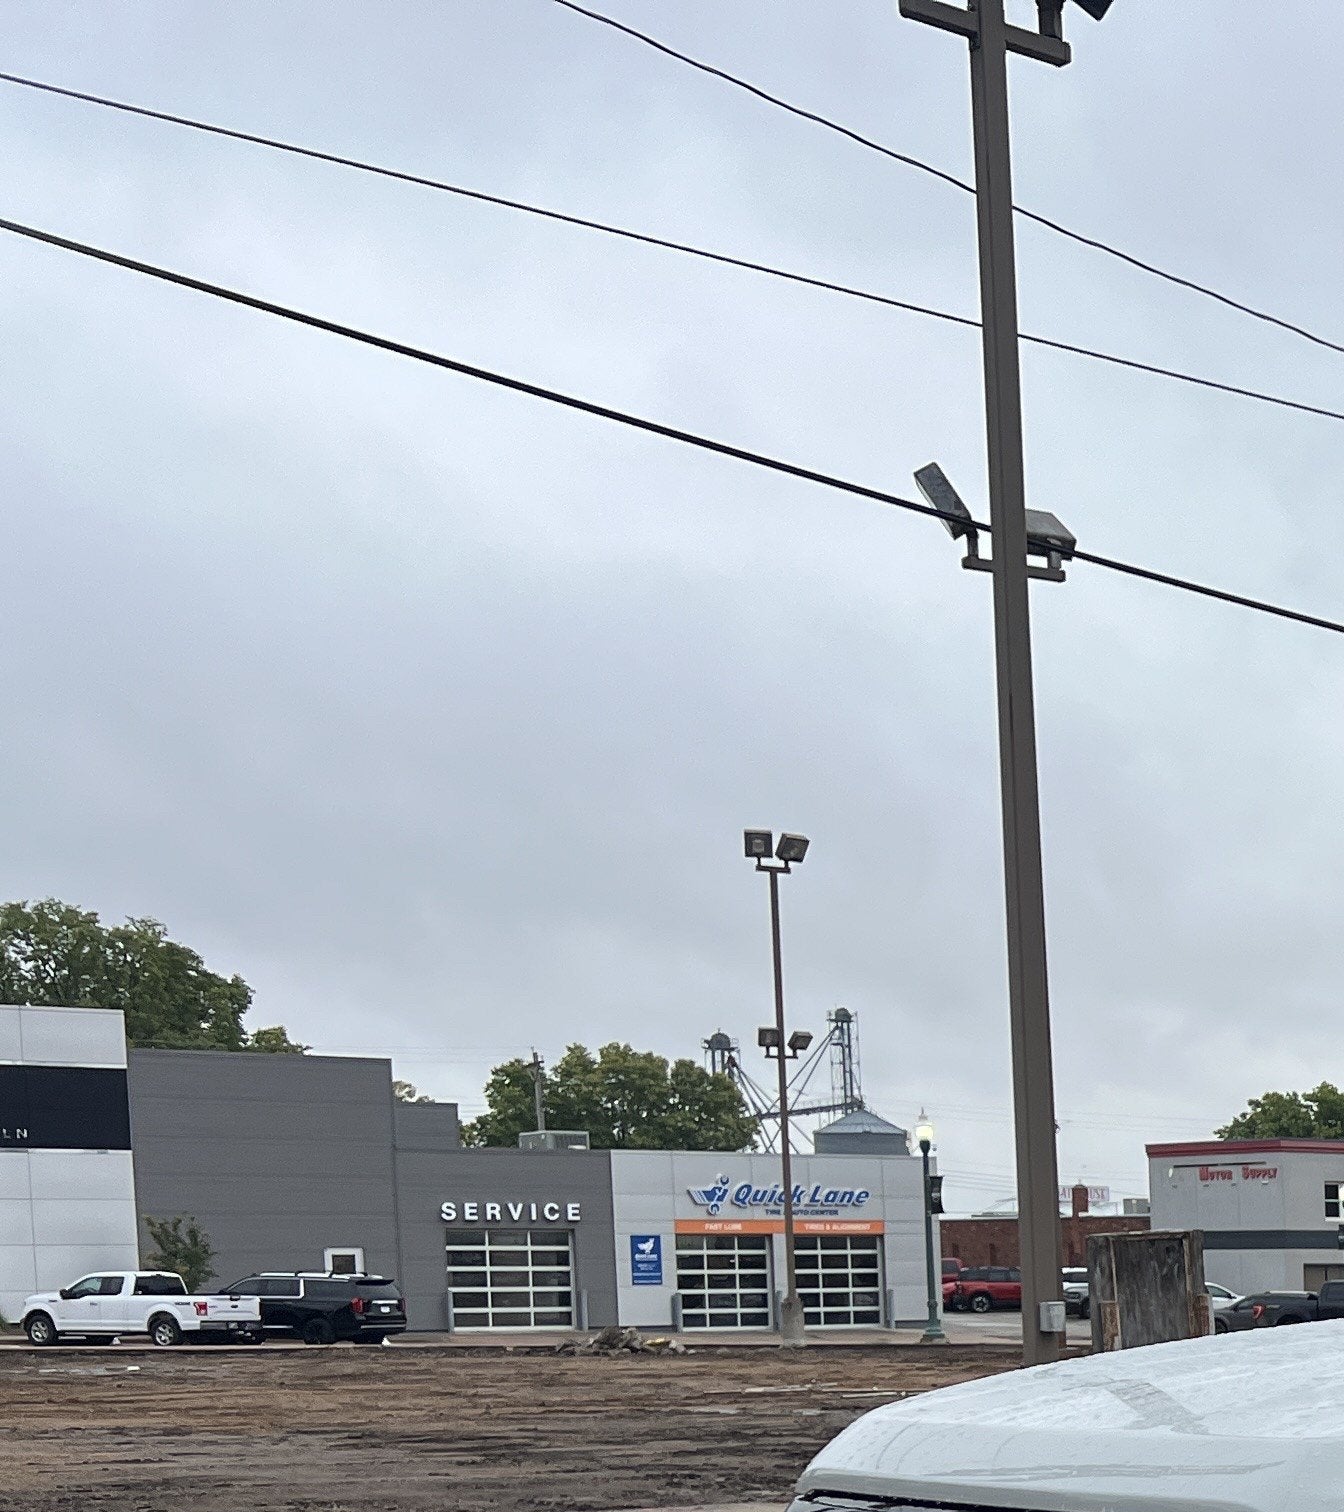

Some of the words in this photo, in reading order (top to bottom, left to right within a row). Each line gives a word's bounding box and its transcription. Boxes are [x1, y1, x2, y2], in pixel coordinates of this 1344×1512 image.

[734, 1184, 806, 1204] Quick
[810, 1184, 870, 1204] Lane
[441, 1202, 581, 1221] SERVICE
